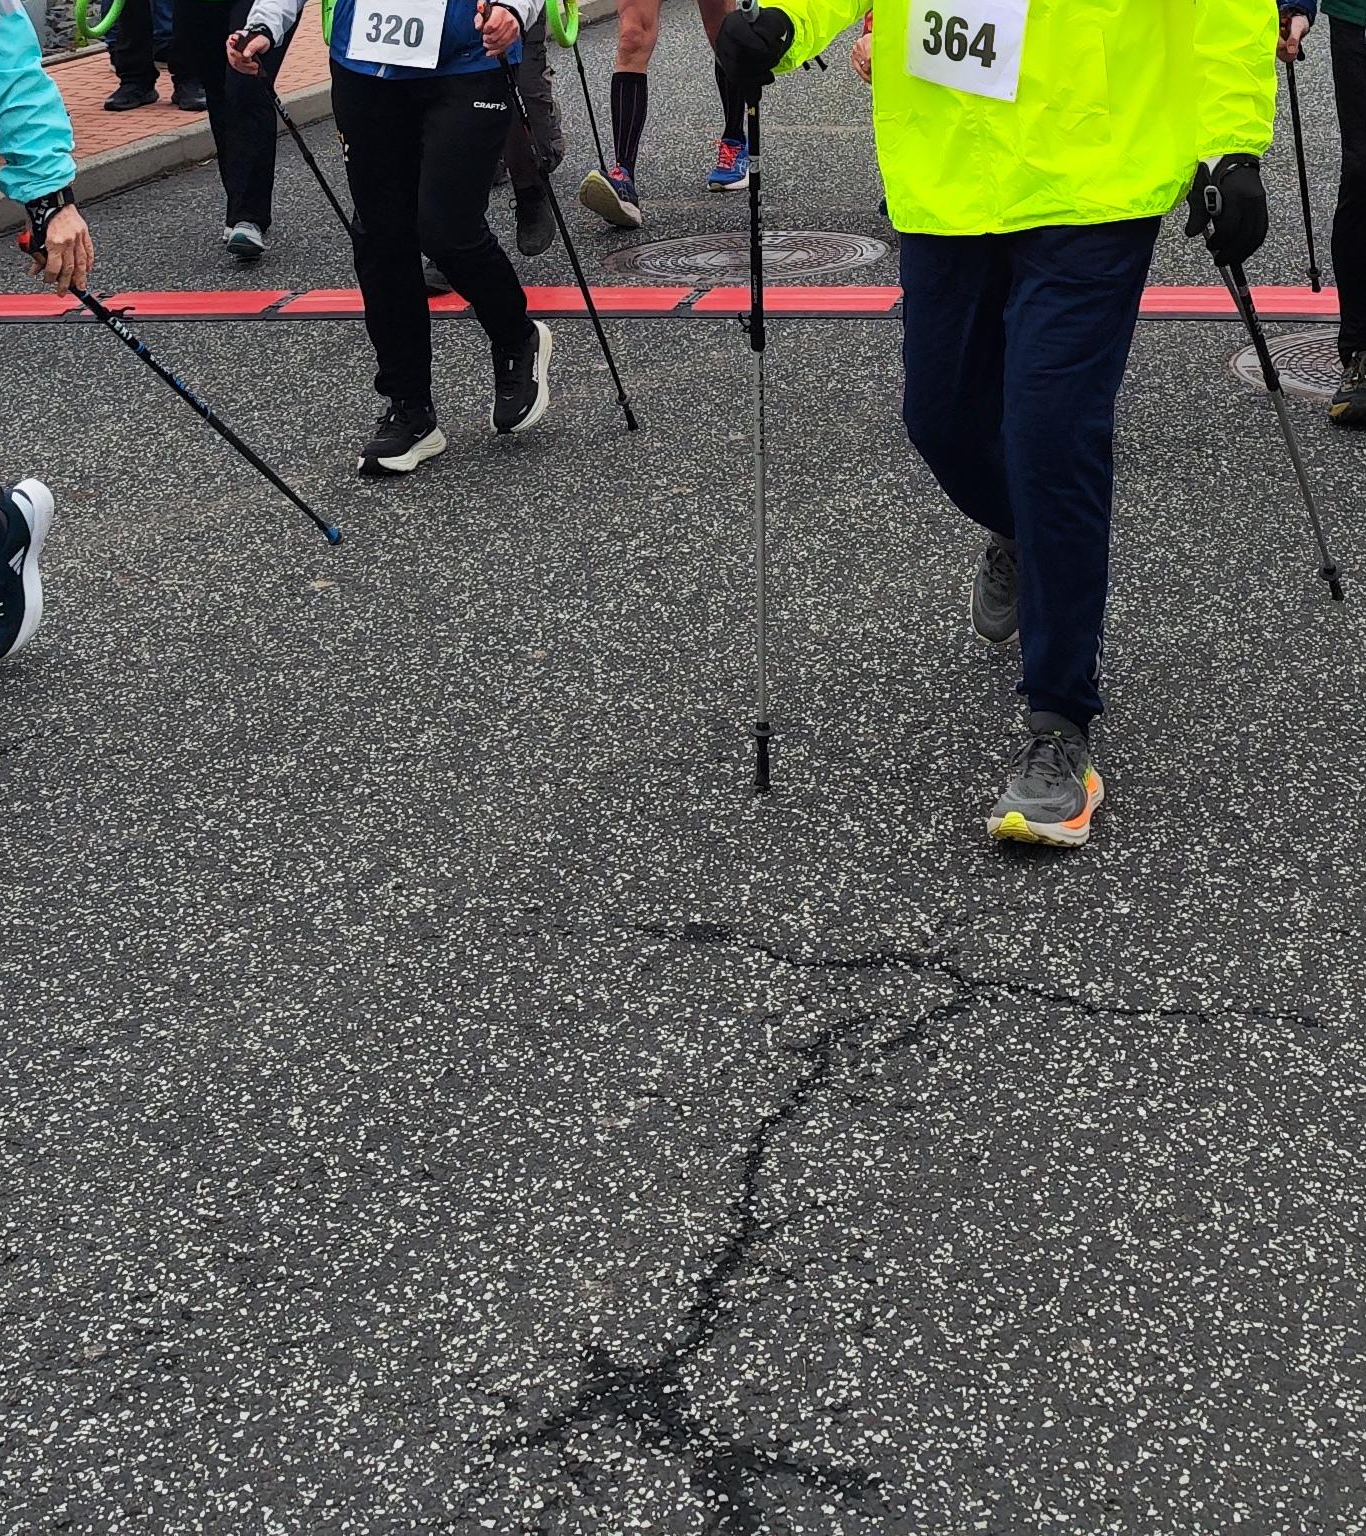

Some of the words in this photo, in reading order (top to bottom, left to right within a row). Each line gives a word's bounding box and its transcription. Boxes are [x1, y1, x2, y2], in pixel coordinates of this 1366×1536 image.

[365, 12, 424, 48] 320
[922, 10, 997, 68] 364
[473, 101, 500, 110] CRAFT
[107, 316, 133, 341] LEKI
